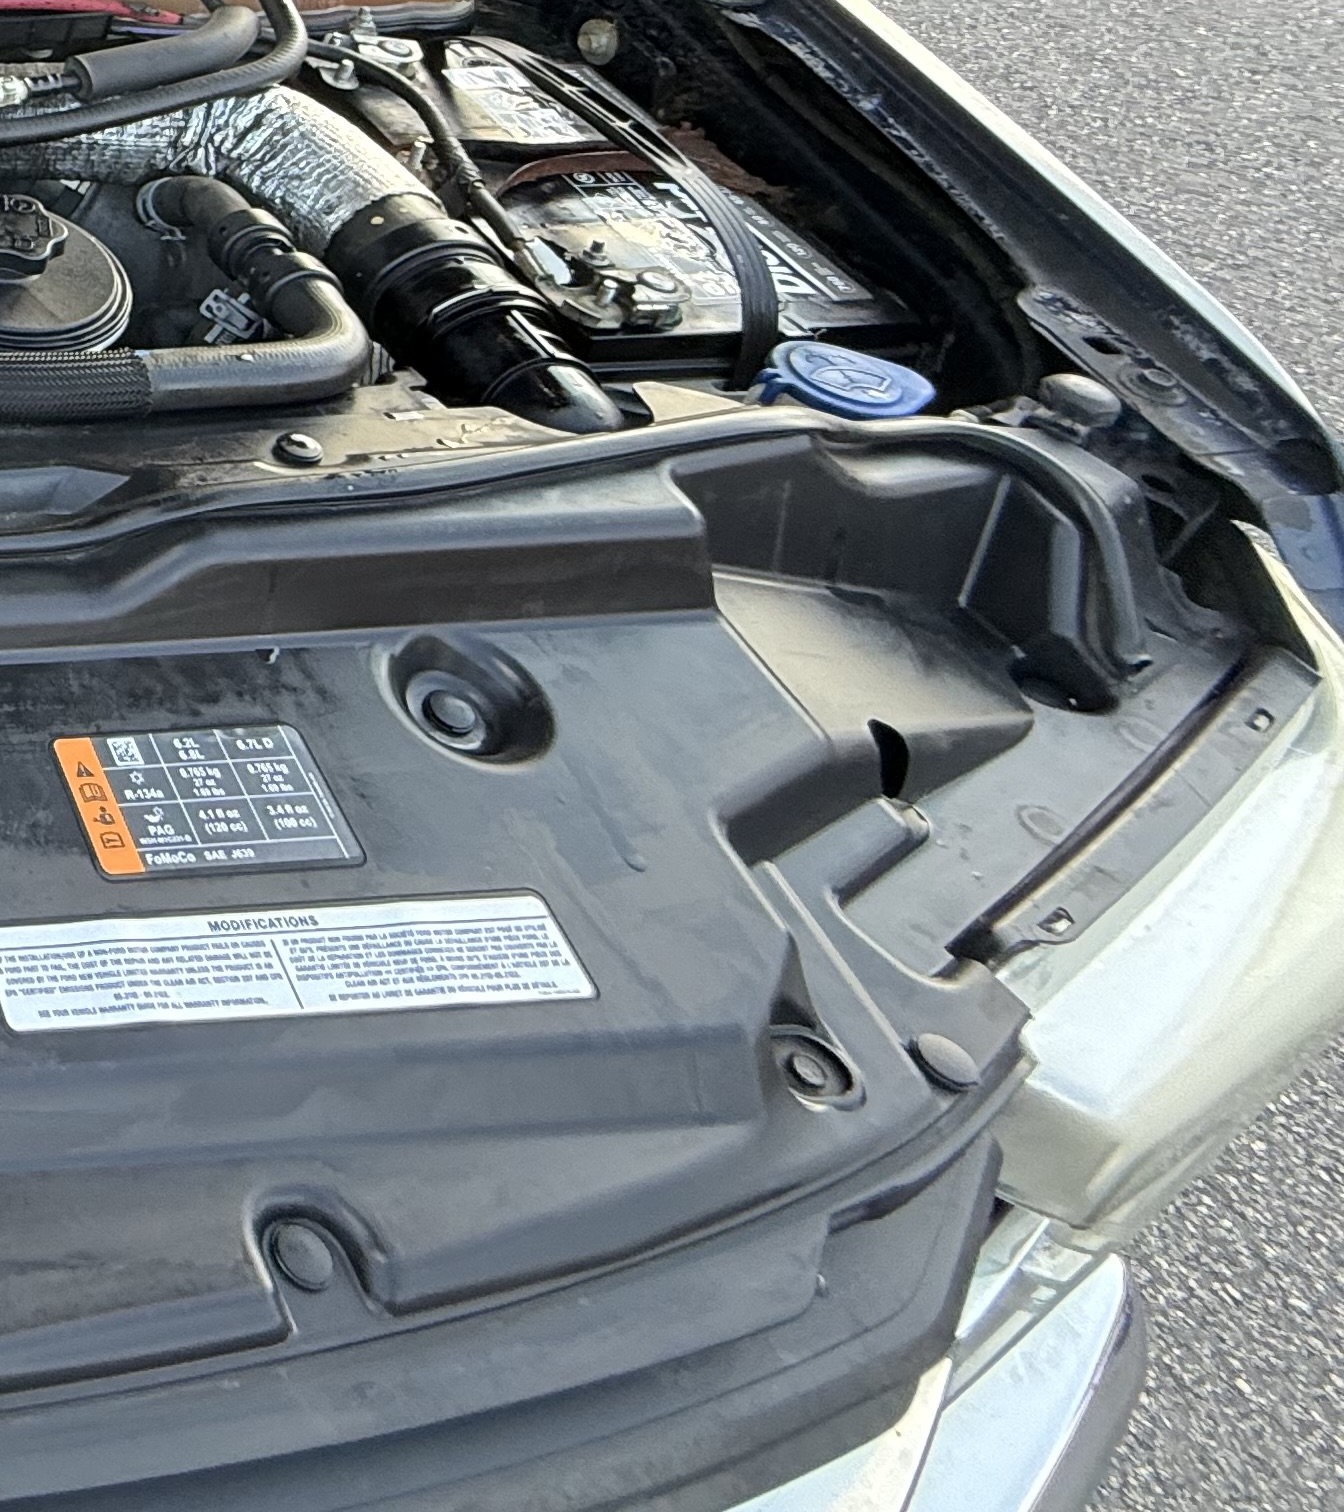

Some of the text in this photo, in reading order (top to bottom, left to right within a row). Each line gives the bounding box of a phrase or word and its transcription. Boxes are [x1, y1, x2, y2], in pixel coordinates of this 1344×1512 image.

[148, 824, 175, 836] PAG
[145, 851, 196, 865] FoMoCo
[204, 849, 227, 861] SAE
[207, 915, 319, 932] MODIFICATIONS
